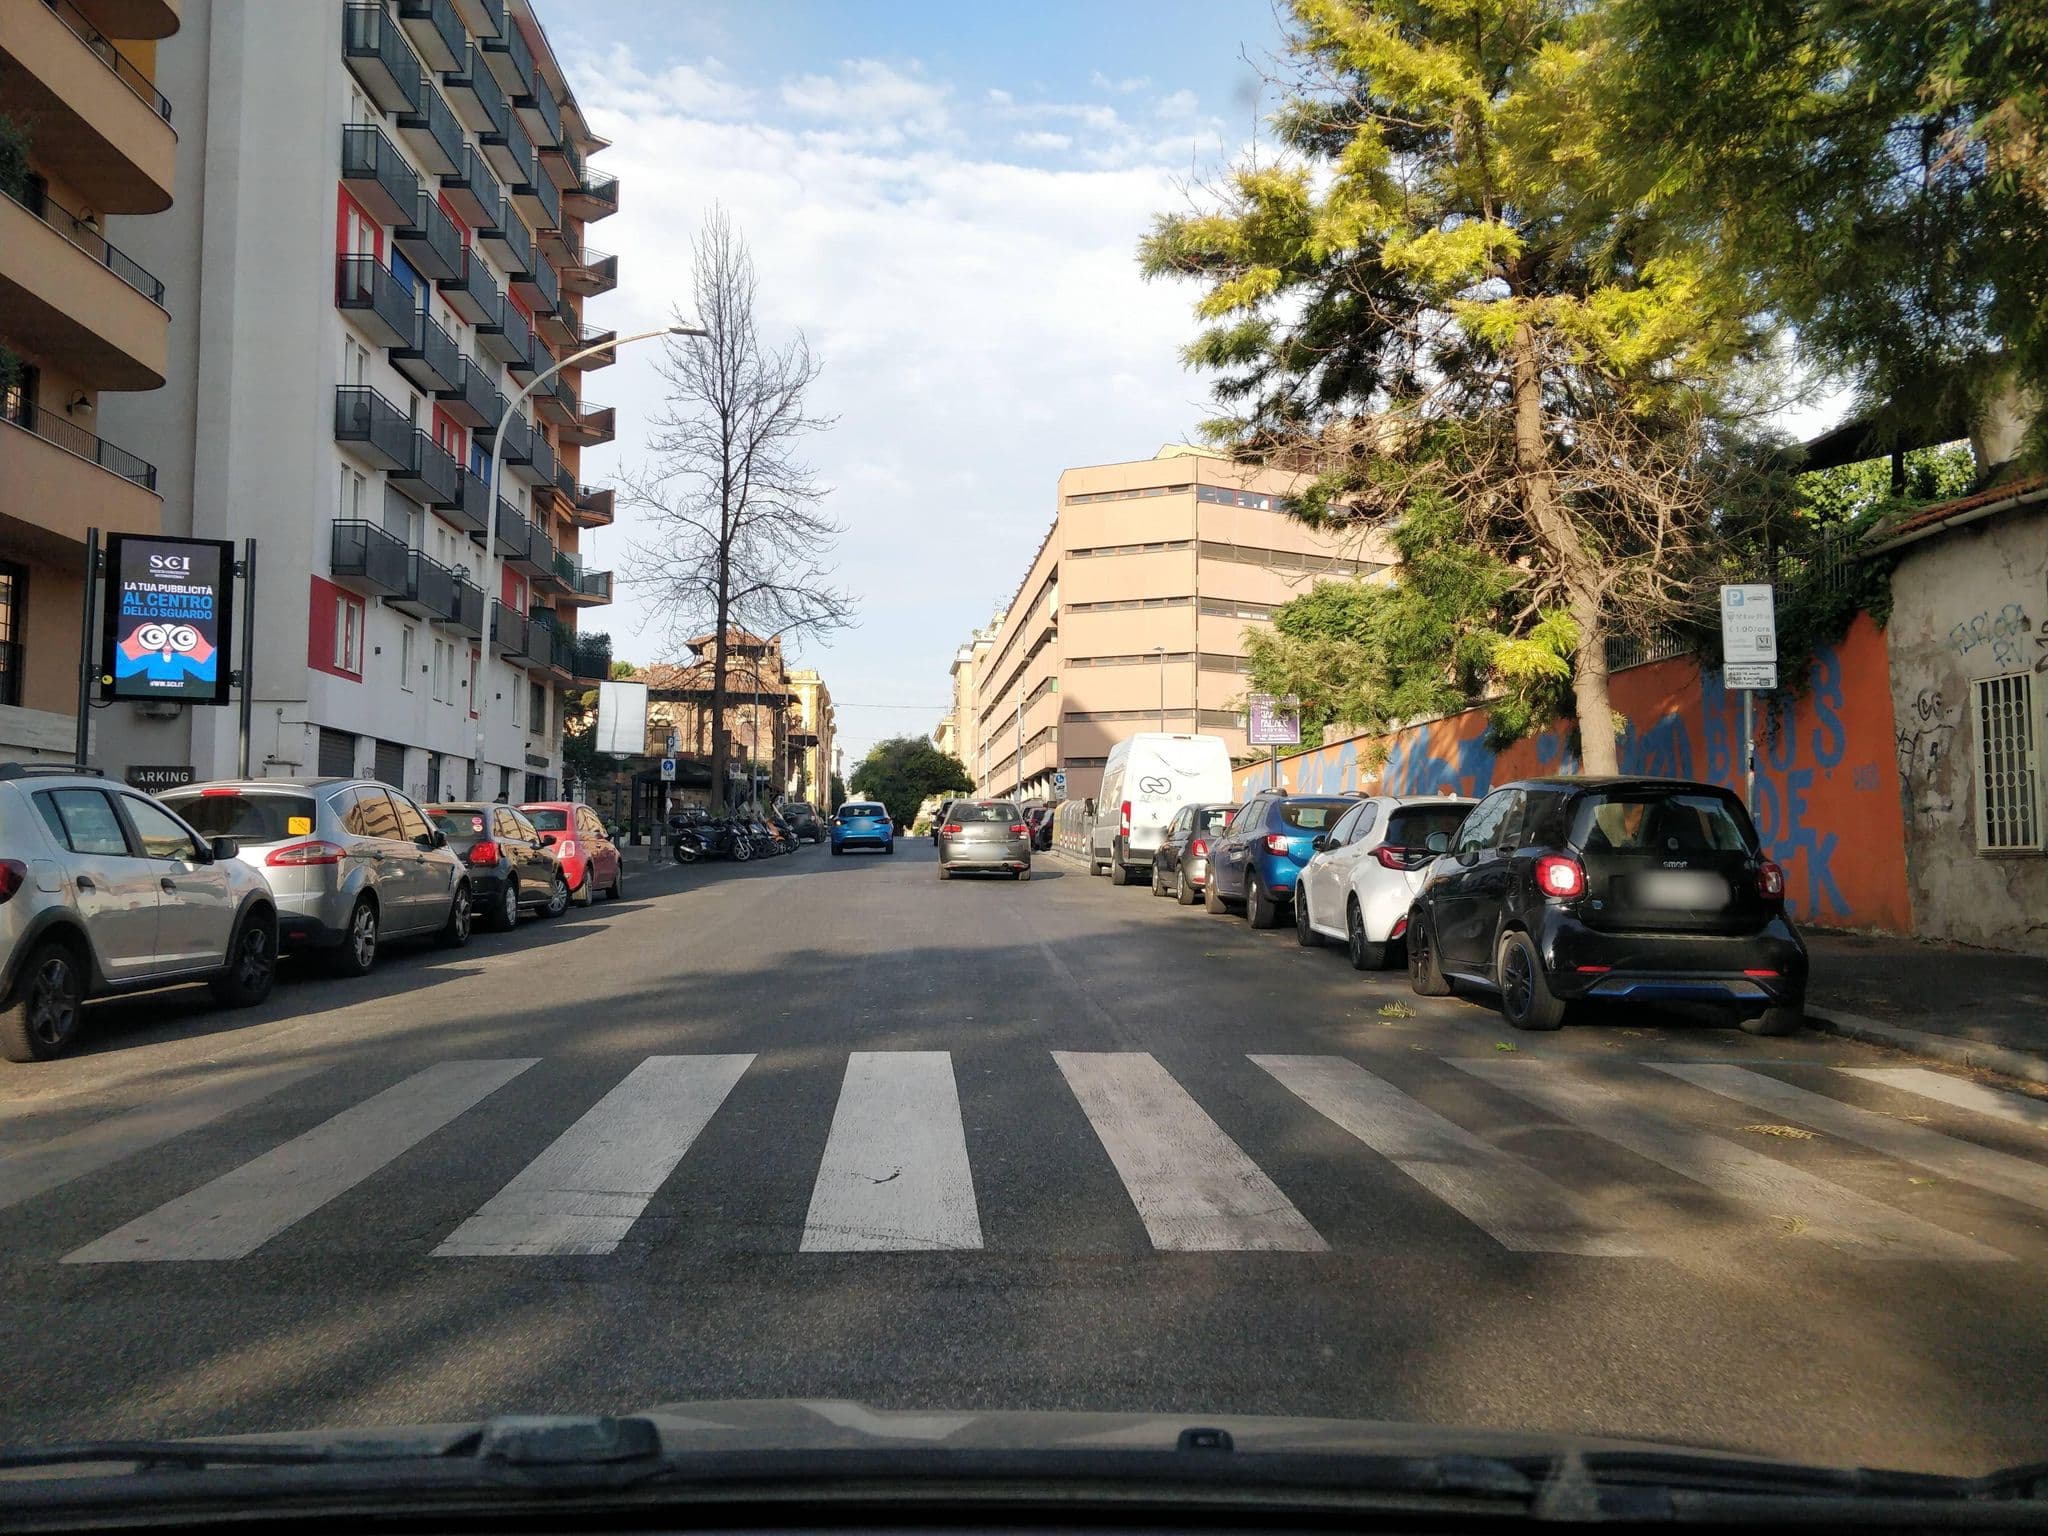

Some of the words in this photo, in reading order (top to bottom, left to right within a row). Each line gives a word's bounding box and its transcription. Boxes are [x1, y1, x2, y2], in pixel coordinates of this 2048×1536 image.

[150, 555, 190, 570] SCI
[124, 581, 136, 590] LA
[138, 582, 157, 592] TUA
[158, 584, 213, 595] PUBBLICITÀ
[123, 592, 144, 605] AL
[147, 593, 213, 610] CENTRO
[123, 606, 158, 617] DELLO
[160, 608, 212, 619] SGUARDO
[133, 772, 189, 782] ARKING
